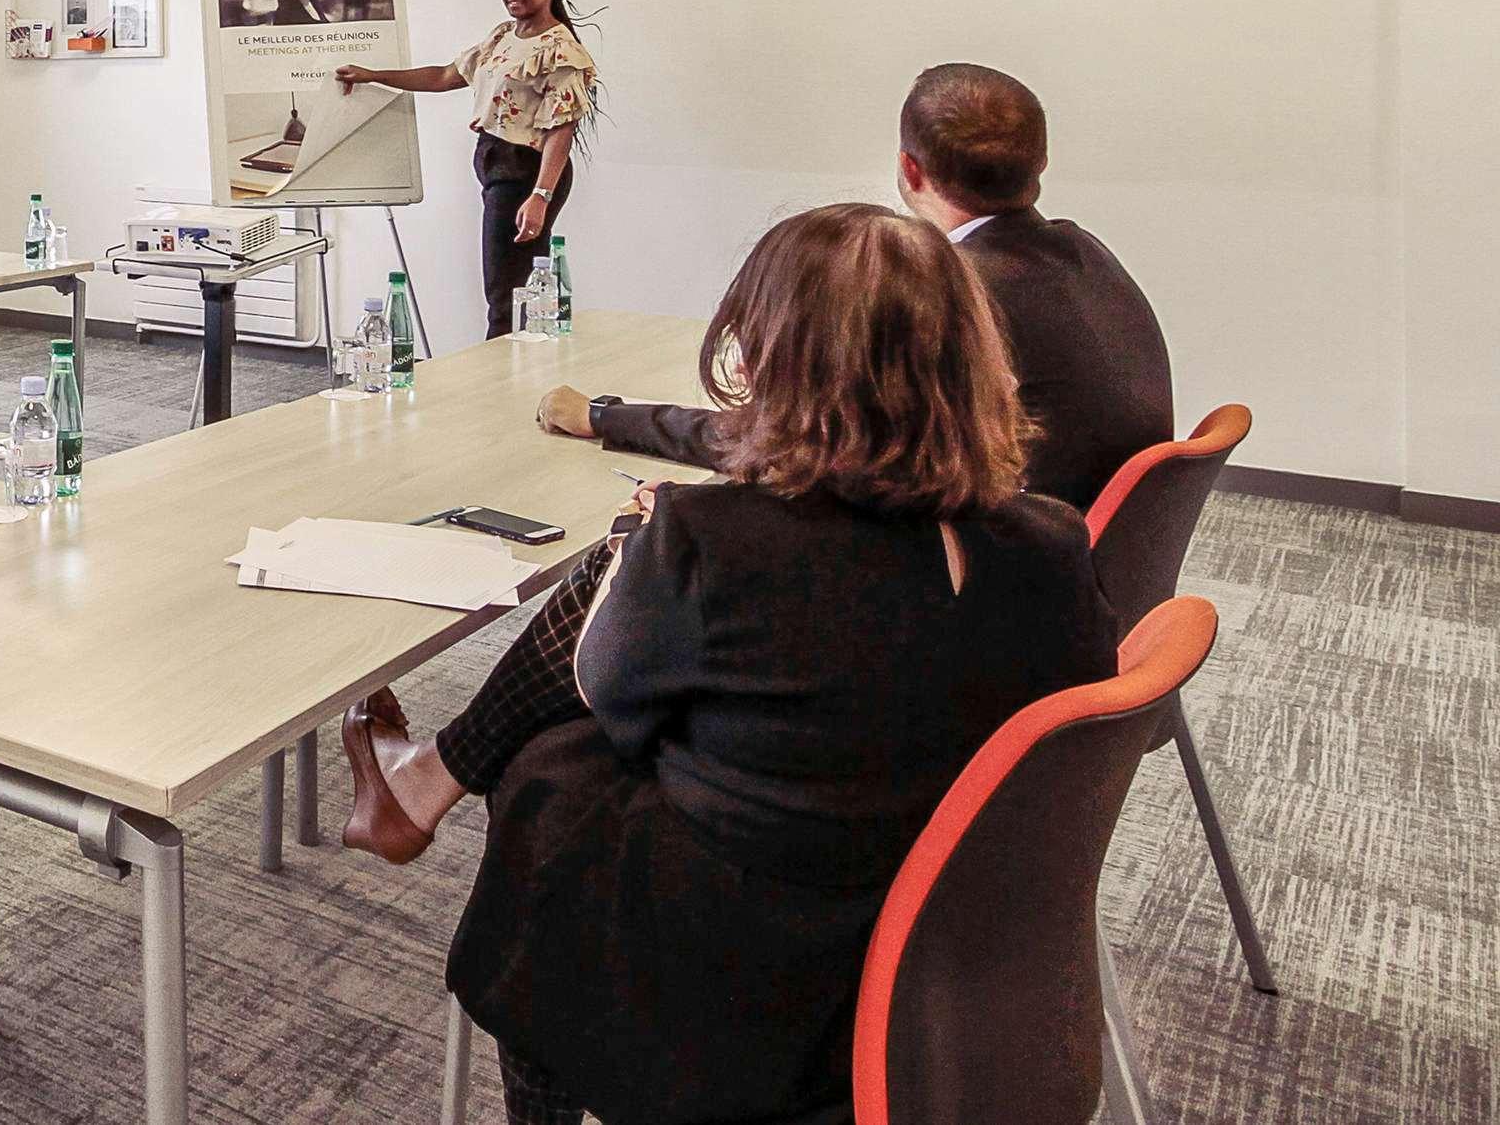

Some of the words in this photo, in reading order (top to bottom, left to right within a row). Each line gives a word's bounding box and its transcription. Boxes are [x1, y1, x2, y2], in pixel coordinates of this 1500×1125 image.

[238, 36, 250, 45] LE
[252, 35, 302, 44] MEILLEUR
[304, 34, 325, 43] DES
[247, 47, 300, 56] MEETINGS
[302, 46, 314, 54] AT
[316, 44, 346, 53] THEIR
[348, 43, 373, 52] BEST
[290, 71, 326, 79] Mercur
[393, 352, 414, 366] ADOIT
